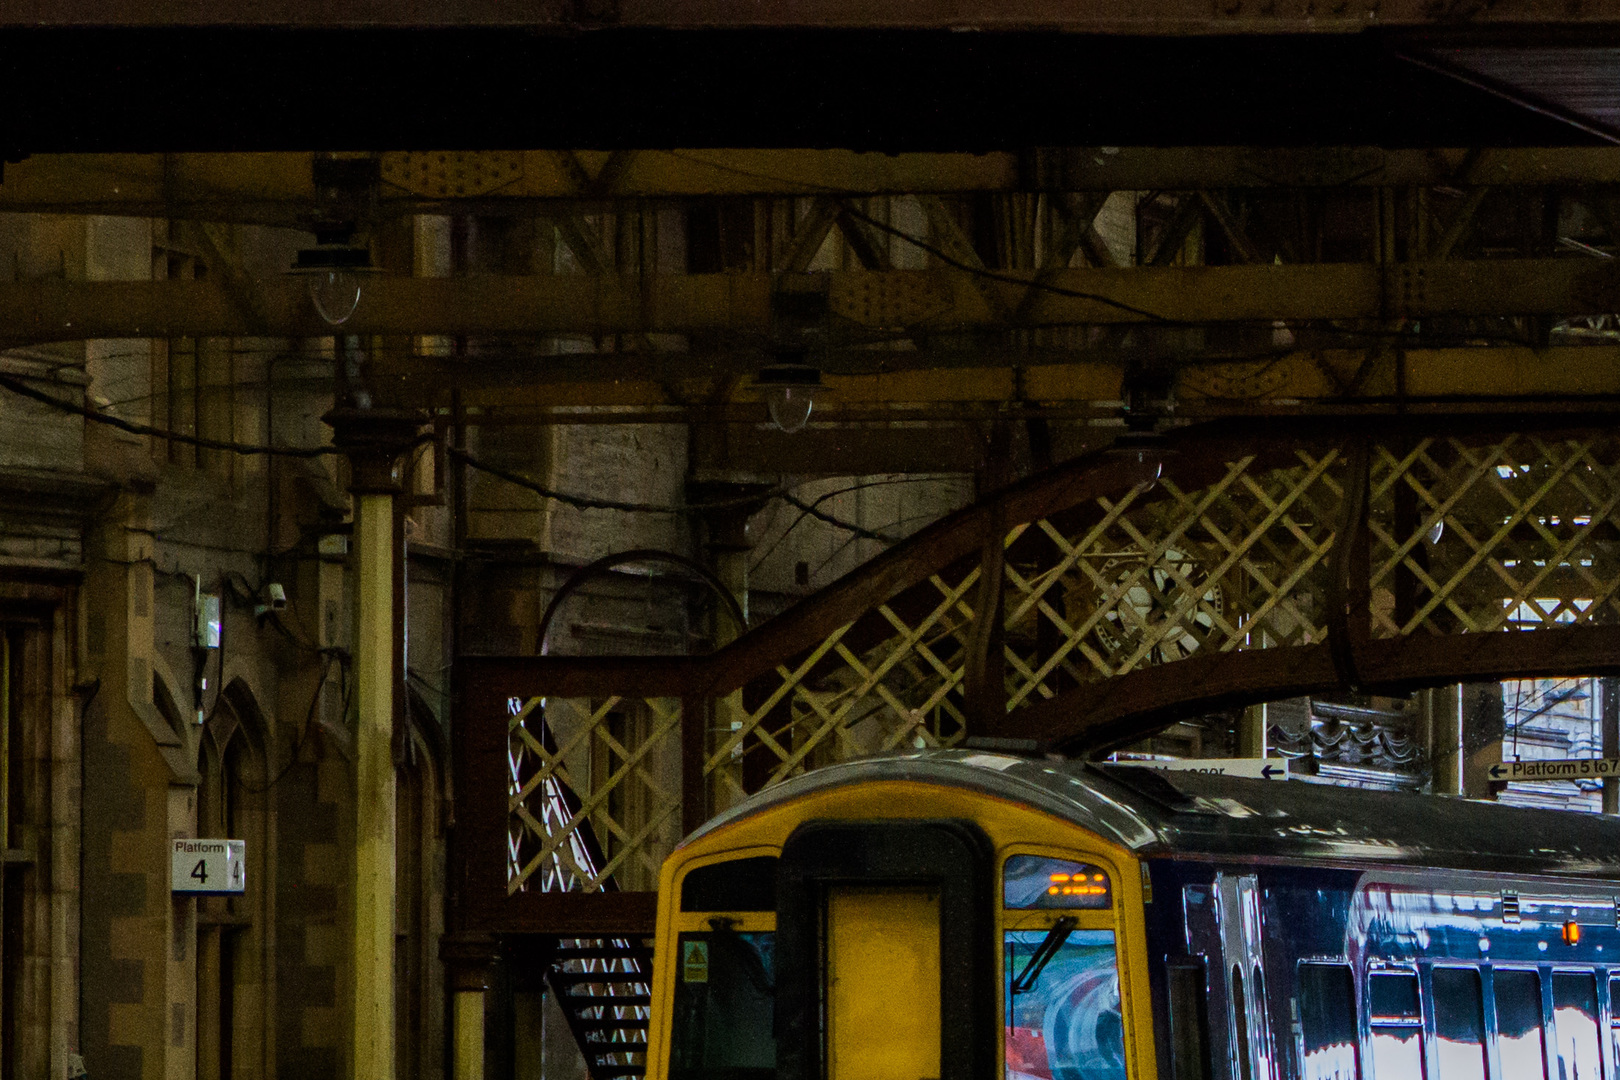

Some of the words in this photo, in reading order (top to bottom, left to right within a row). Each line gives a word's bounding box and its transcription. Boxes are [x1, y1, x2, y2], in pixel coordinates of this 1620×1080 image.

[1512, 762, 1576, 776] Platform
[1580, 761, 1590, 773] 5
[1594, 761, 1608, 773] to
[1611, 760, 1619, 772] 7
[175, 842, 225, 854] Platform
[191, 859, 208, 884] 4
[233, 860, 240, 885] 4
